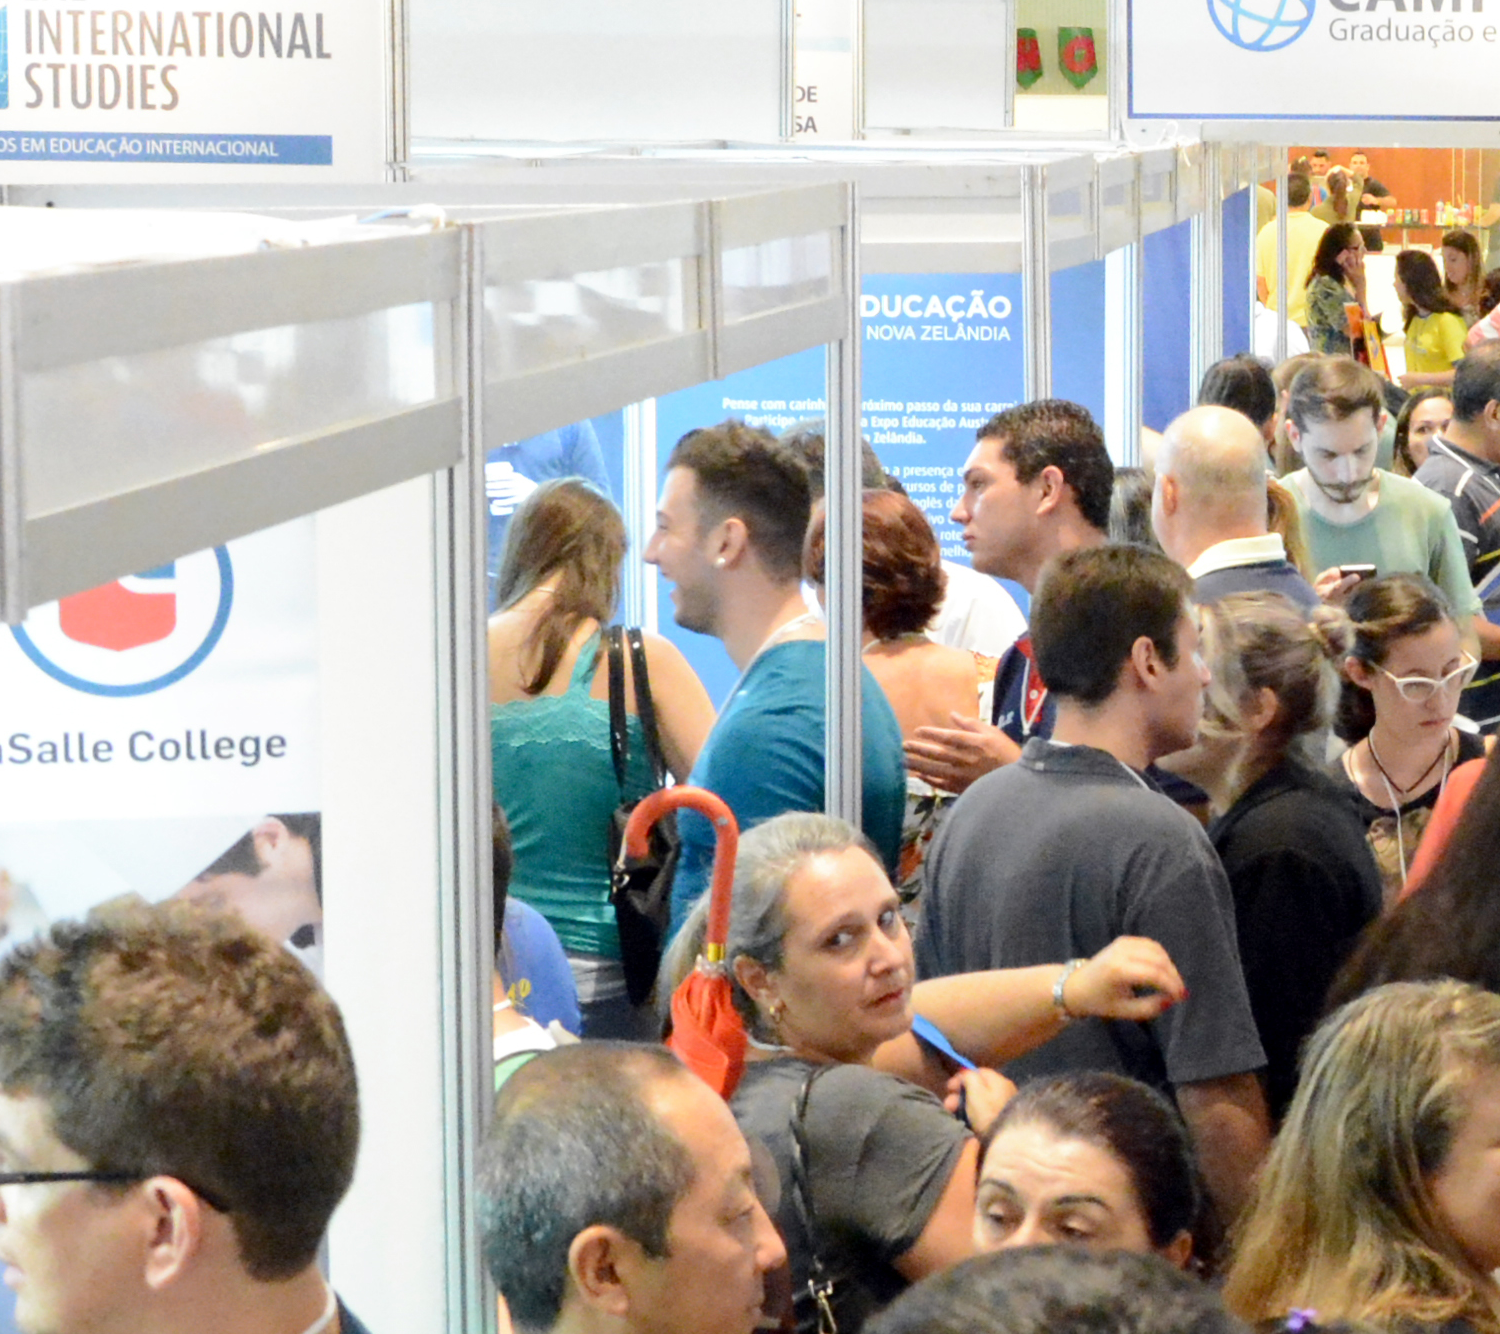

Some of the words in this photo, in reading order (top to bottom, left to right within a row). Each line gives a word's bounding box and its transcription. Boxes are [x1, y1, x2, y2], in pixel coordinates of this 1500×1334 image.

[23, 11, 332, 60] INTERNATIONAL
[1330, 17, 1475, 48] Graduação
[1482, 25, 1498, 43] e
[23, 62, 181, 111] STUDIES
[20, 137, 46, 155] EM
[49, 133, 143, 159] EDUCAÇÃO
[146, 137, 280, 157] INTERNACIONAL
[860, 290, 1012, 323] DUCAÇÃO
[866, 325, 916, 341] NOVA
[920, 321, 1011, 342] ZELÂNDIA
[722, 398, 758, 410] Pense
[761, 400, 787, 410] com
[789, 398, 825, 410] carinh
[863, 399, 905, 411] róximo
[906, 400, 941, 413] passo
[943, 399, 958, 411] da
[961, 401, 982, 412] sua
[871, 417, 899, 430] Expo
[902, 416, 957, 430] Educação
[127, 729, 288, 769] College
